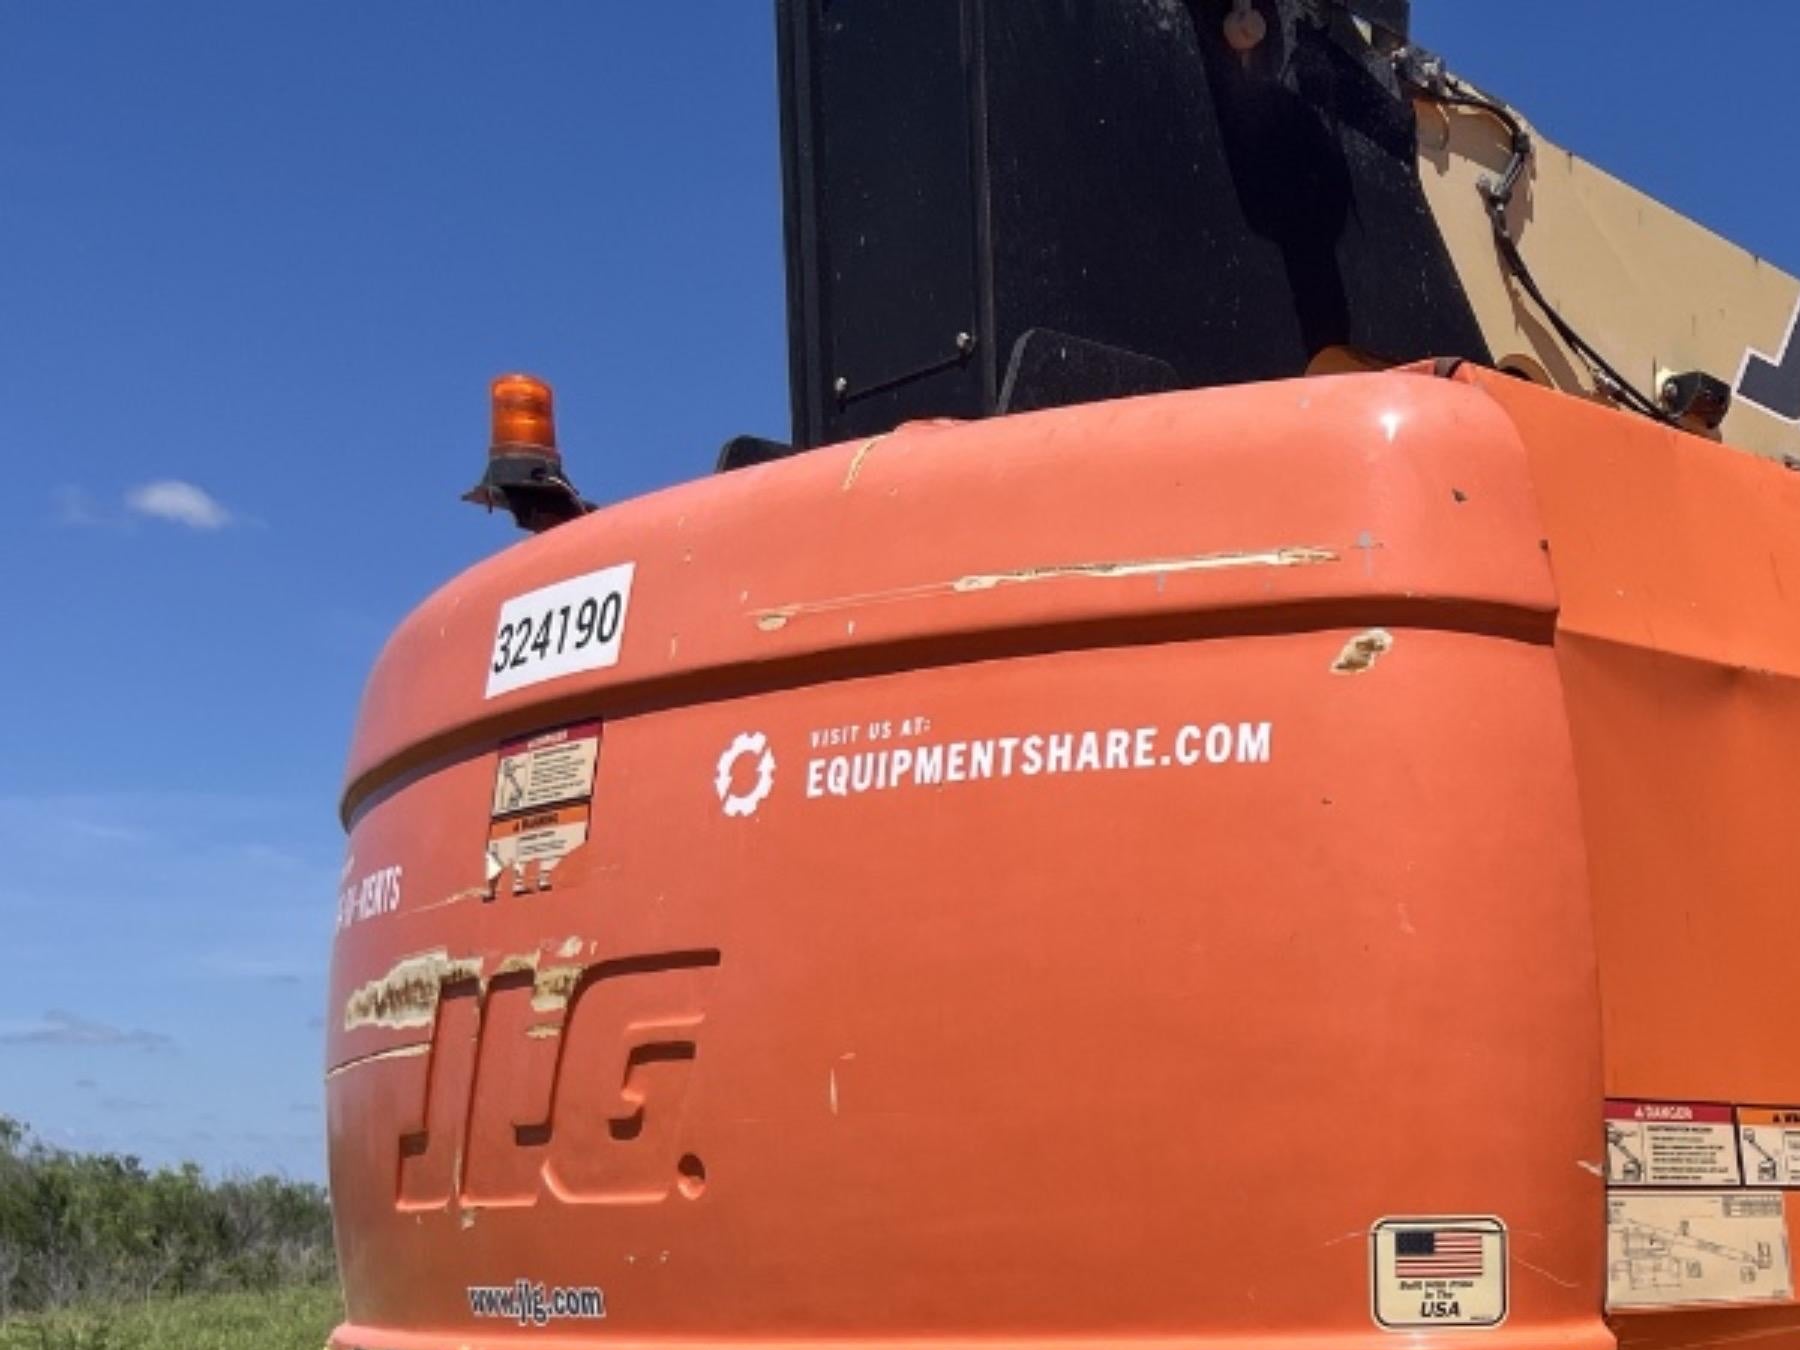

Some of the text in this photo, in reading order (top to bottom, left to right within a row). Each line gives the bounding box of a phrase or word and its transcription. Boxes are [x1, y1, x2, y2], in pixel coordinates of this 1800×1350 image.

[493, 590, 623, 674] 324190
[811, 725, 860, 748] VISIT
[868, 720, 892, 741] US
[806, 720, 1272, 799] EQUIPMENTSHARE.COM
[468, 1279, 606, 1325] www.jlg.com
[1420, 1301, 1461, 1318] USA
